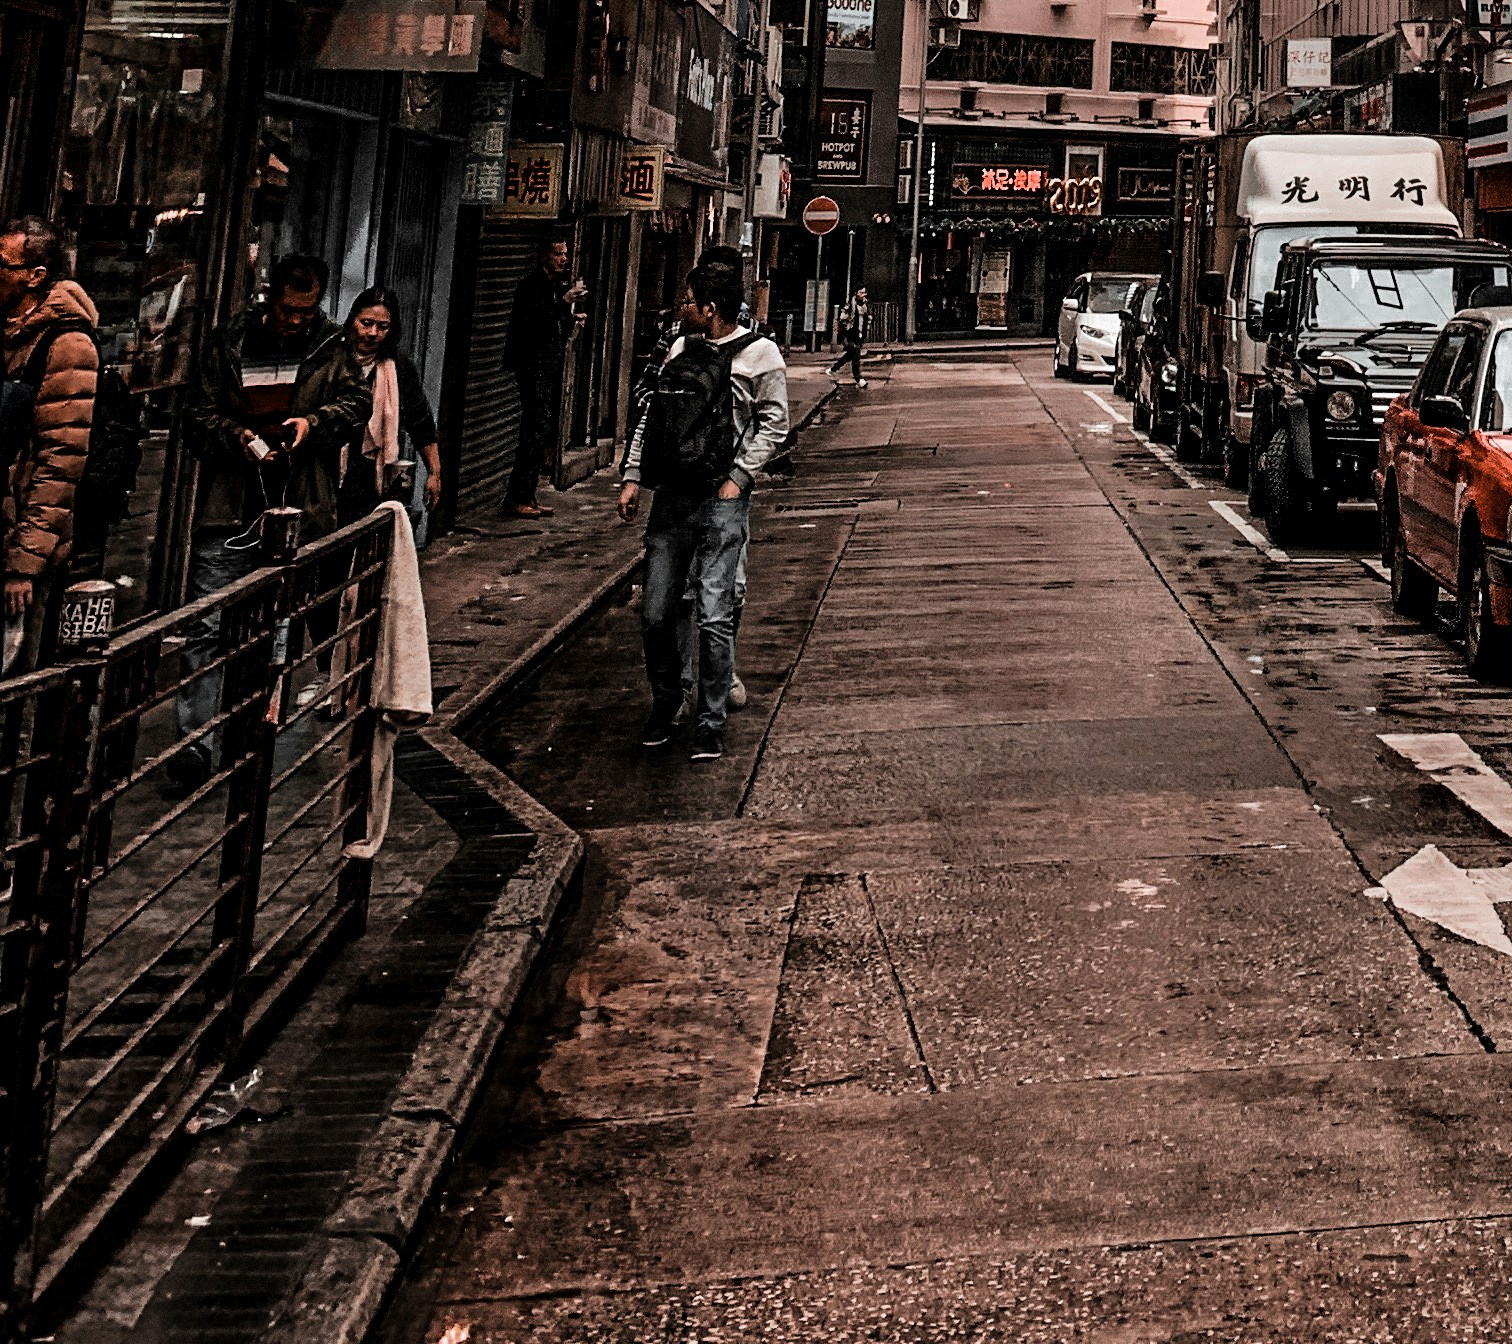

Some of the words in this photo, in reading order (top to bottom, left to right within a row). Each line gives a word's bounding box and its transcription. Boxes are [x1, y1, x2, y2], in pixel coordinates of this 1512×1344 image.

[821, 142, 855, 153] HOTPOT
[817, 160, 857, 170] BREWPUB
[1050, 176, 1101, 210] 2019
[1282, 176, 1428, 207] 光明行
